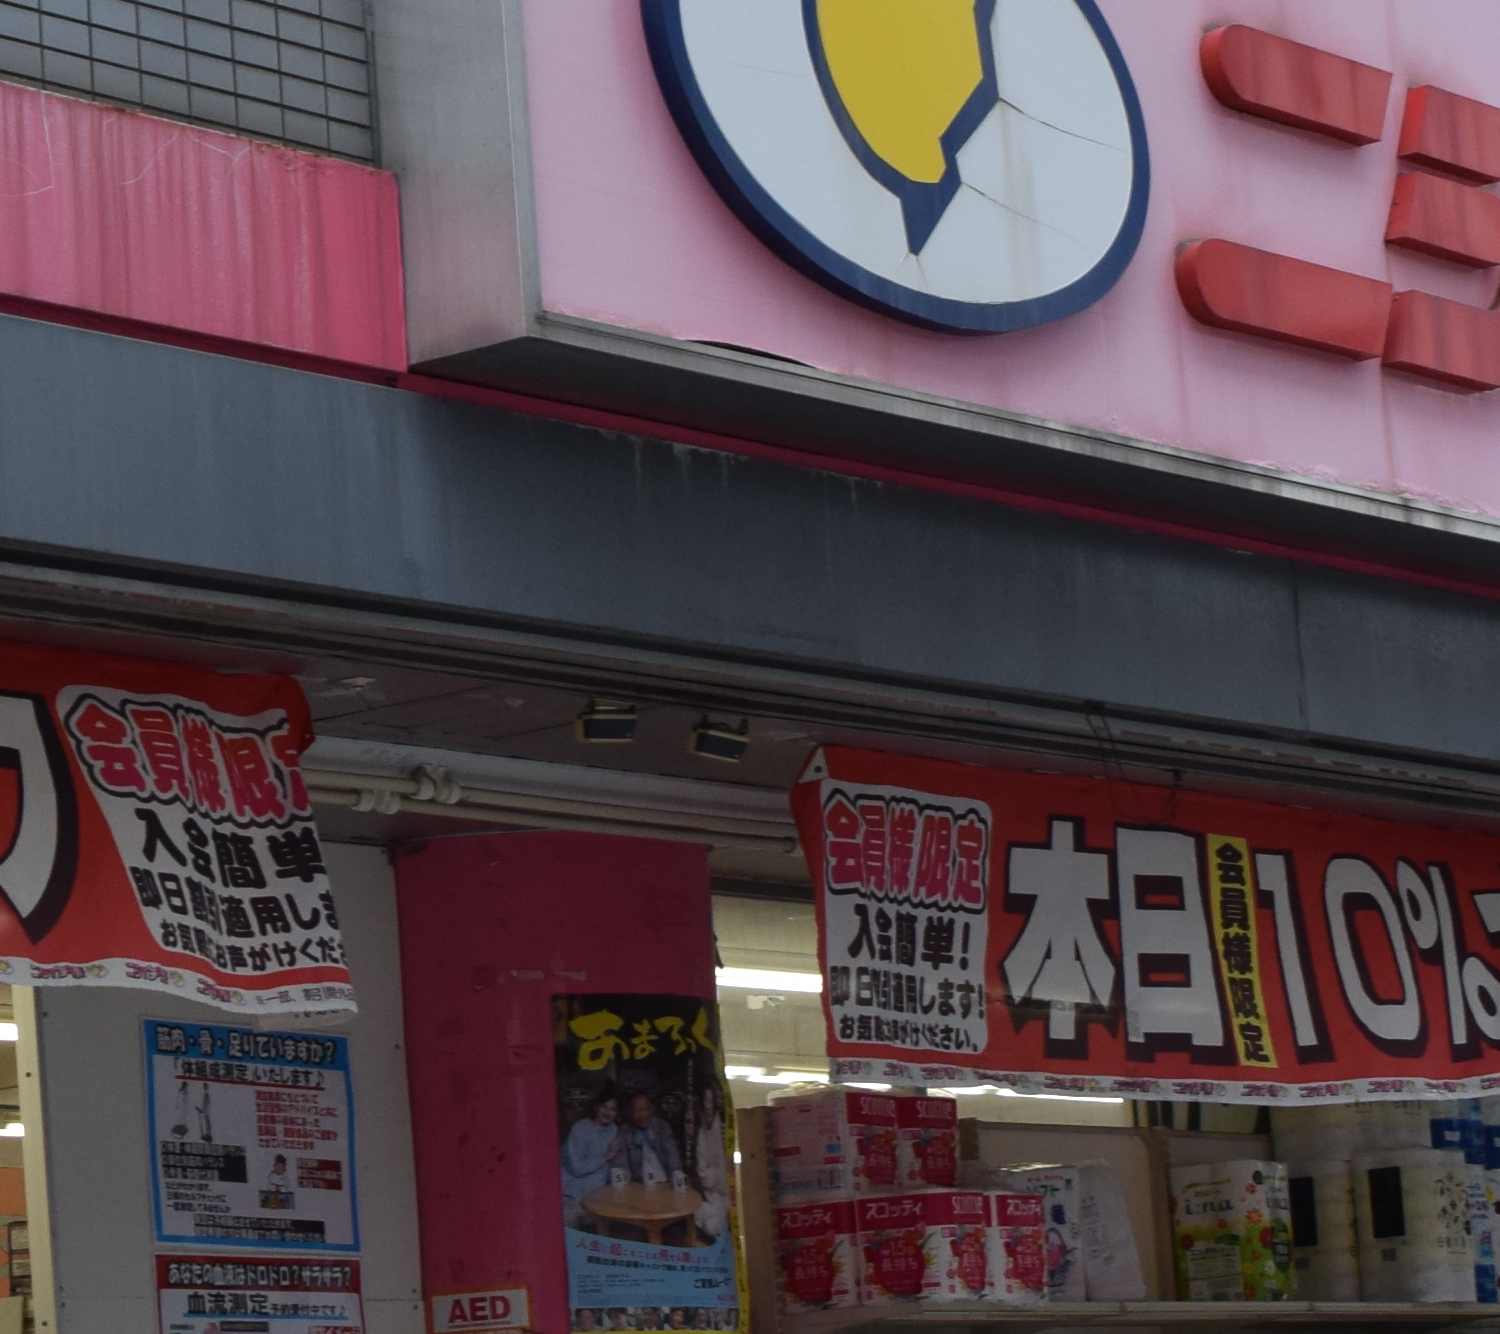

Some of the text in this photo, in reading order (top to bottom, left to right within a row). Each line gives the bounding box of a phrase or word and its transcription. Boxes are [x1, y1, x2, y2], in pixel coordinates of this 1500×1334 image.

[824, 794, 987, 908] 会員様限定
[1002, 819, 1226, 1049] 本日
[448, 1294, 512, 1324] AED
